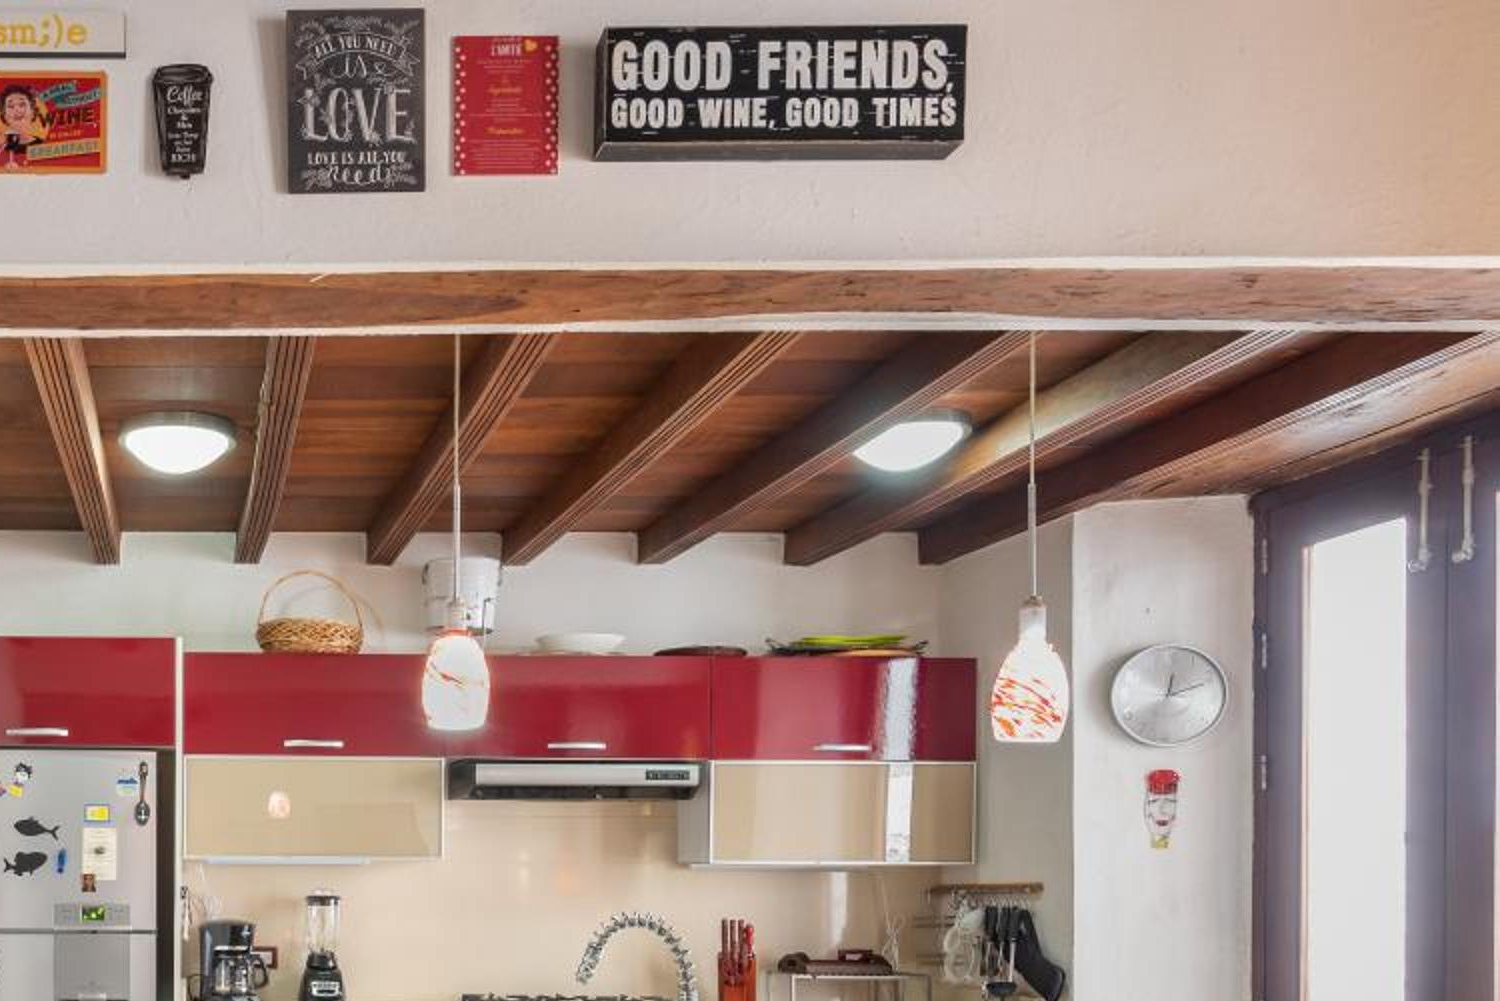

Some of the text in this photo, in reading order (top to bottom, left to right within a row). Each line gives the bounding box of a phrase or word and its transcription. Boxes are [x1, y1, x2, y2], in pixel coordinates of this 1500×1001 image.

[314, 38, 335, 58] ALL
[338, 35, 360, 50] YOU
[611, 39, 955, 93] GOOD FRIENDS,
[167, 84, 203, 106] Coffee
[38, 107, 95, 128] WINE
[303, 87, 415, 142] LOVE
[610, 97, 957, 129] GOOD WINE, GOOD TIMES
[308, 151, 406, 165] LOVE IS ALL YOU
